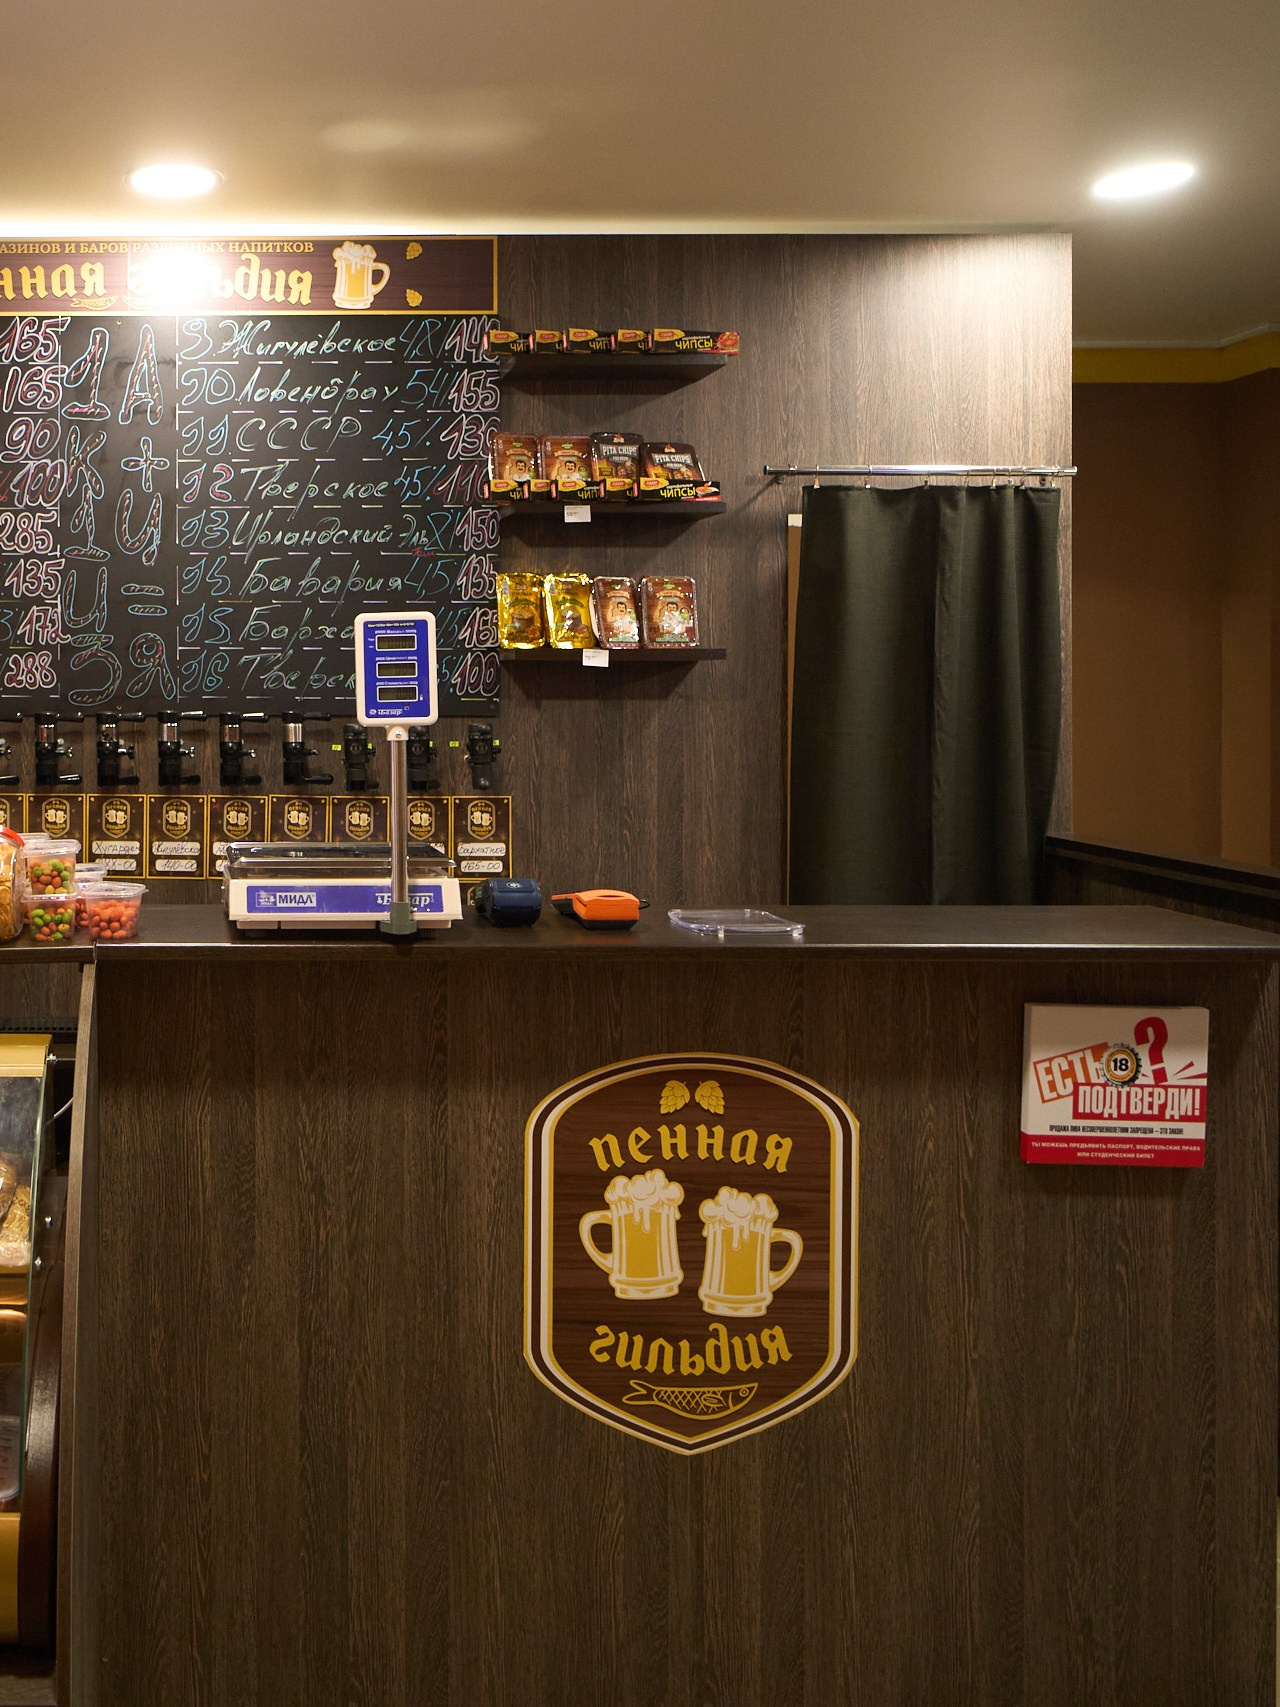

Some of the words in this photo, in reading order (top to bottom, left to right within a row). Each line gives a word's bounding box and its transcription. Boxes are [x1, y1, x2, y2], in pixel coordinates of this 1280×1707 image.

[65, 243, 76, 254] И
[79, 242, 128, 255] БАРОВ
[228, 241, 314, 253] НАПИТКОВ
[588, 341, 611, 351] ЧИП
[675, 339, 713, 350] ЧИПСЫ
[2, 366, 68, 412] 165
[449, 368, 501, 412] 155
[0, 417, 61, 463] 90
[236, 416, 362, 452] СССР
[576, 490, 600, 500] ЧИП
[659, 488, 696, 499] ЧИПСЫ
[456, 506, 501, 551] 150
[5, 558, 65, 598] 135
[238, 557, 402, 617] Бавария
[457, 553, 499, 600] 135
[458, 606, 499, 648] 165
[5, 651, 56, 689] 288
[451, 651, 501, 696] 100
[278, 893, 314, 905] МИДЛ
[1035, 1048, 1104, 1100] ЕСТЬ
[1112, 1057, 1129, 1072] 18
[1077, 1085, 1201, 1120] ПОДТВЕРДИ!
[588, 1123, 793, 1173] пенная
[589, 1322, 793, 1376] гильдия
